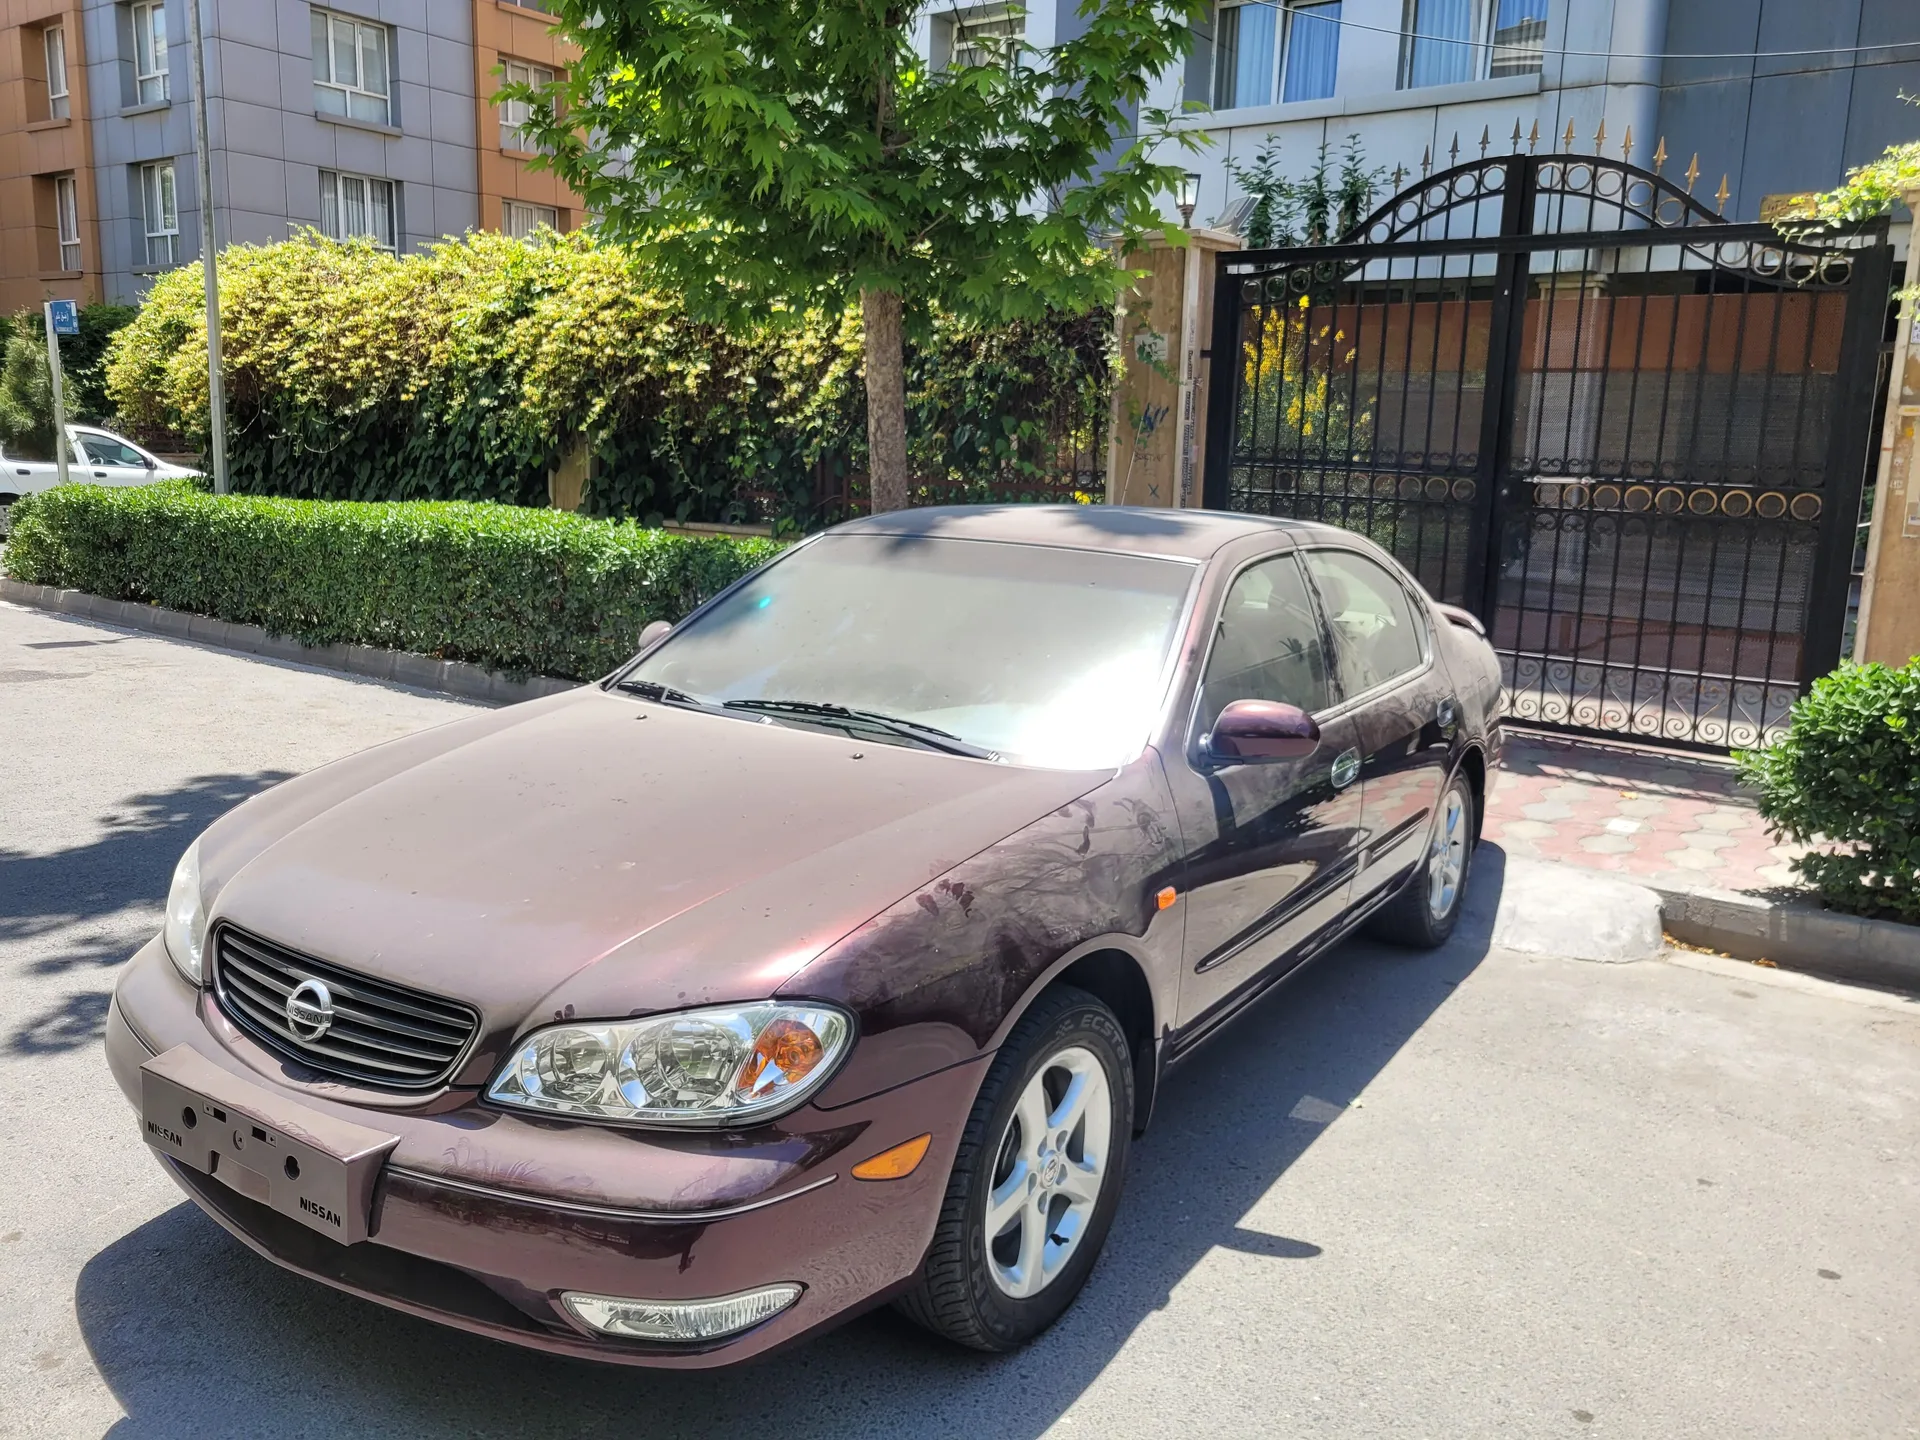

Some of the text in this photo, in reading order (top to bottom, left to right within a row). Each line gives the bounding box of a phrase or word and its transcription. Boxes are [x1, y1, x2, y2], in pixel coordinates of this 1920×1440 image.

[288, 1002, 323, 1024] NISSAN
[147, 1120, 183, 1148] NISSAN
[299, 1196, 341, 1228] NISSAN
